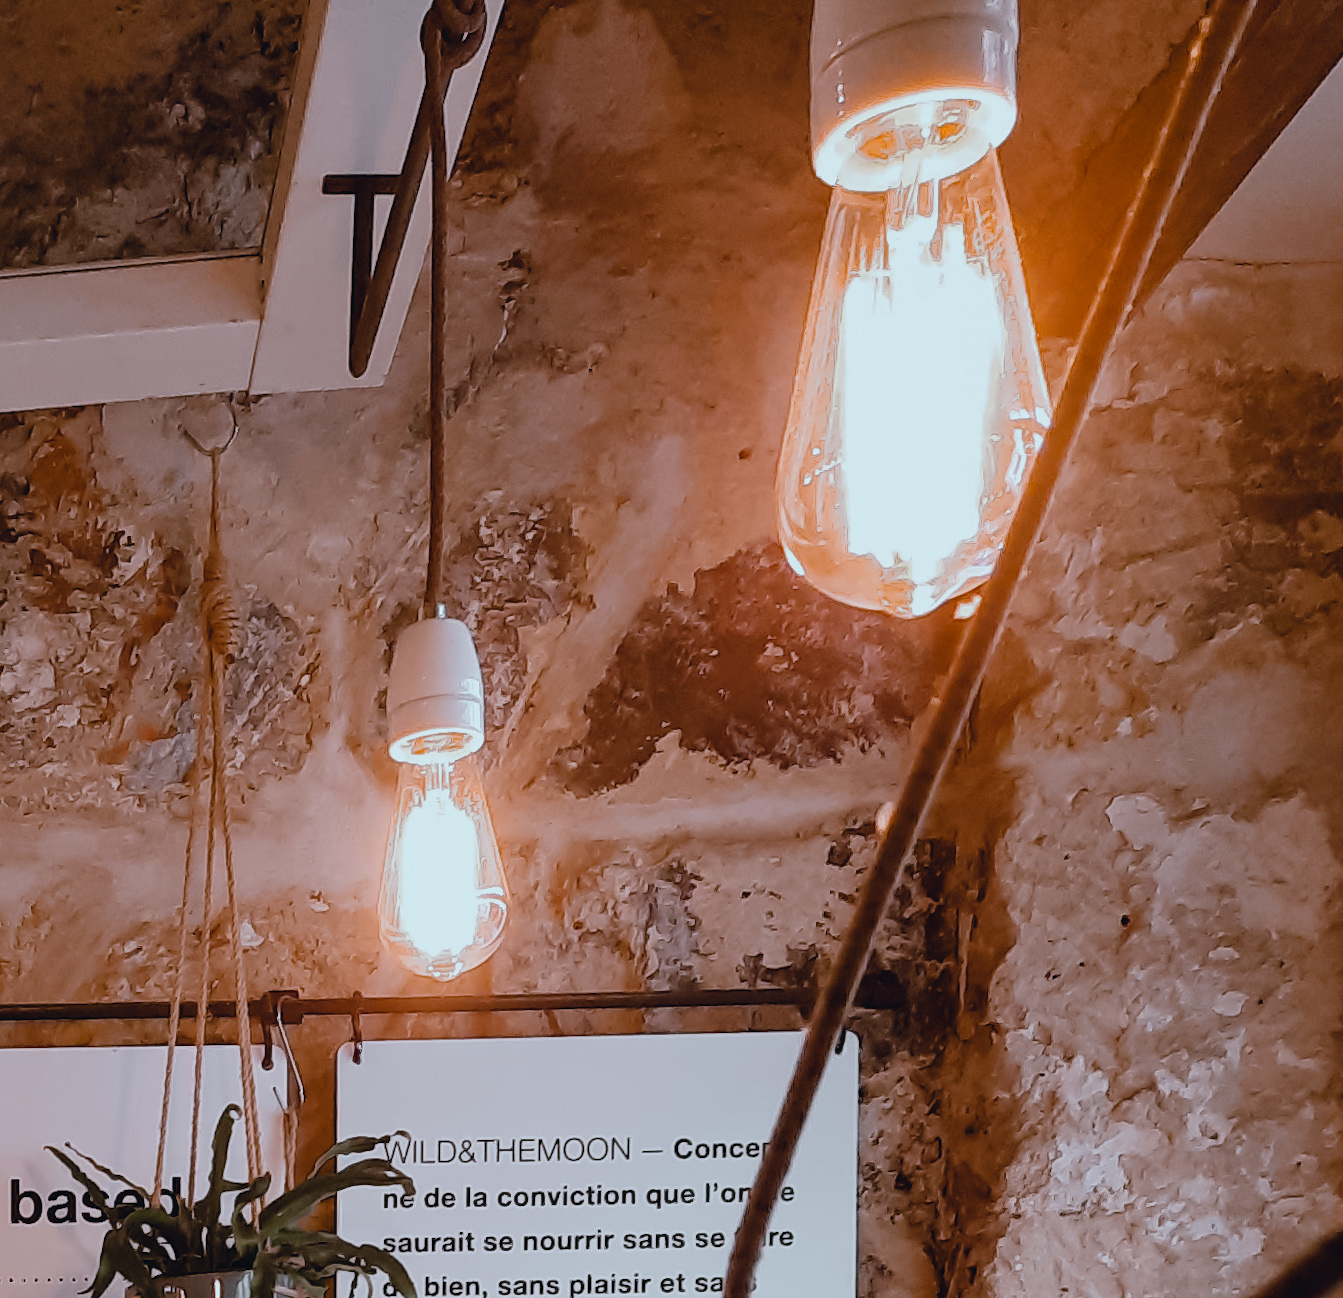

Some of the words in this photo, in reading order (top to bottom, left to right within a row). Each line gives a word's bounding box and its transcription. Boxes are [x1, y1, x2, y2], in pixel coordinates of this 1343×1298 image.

[385, 1138, 631, 1164] WILD&THEMOON
[423, 1187, 457, 1209] de
[465, 1186, 488, 1208] la
[497, 1184, 636, 1208] conviction
[645, 1188, 696, 1210] que
[383, 1232, 475, 1253] saurait
[483, 1235, 514, 1252] se
[523, 1229, 615, 1252] nourrir
[623, 1232, 686, 1250] sans
[695, 1232, 726, 1249] se
[498, 1279, 560, 1296] sans
[660, 1273, 686, 1294] et
[694, 1275, 758, 1293] sa
